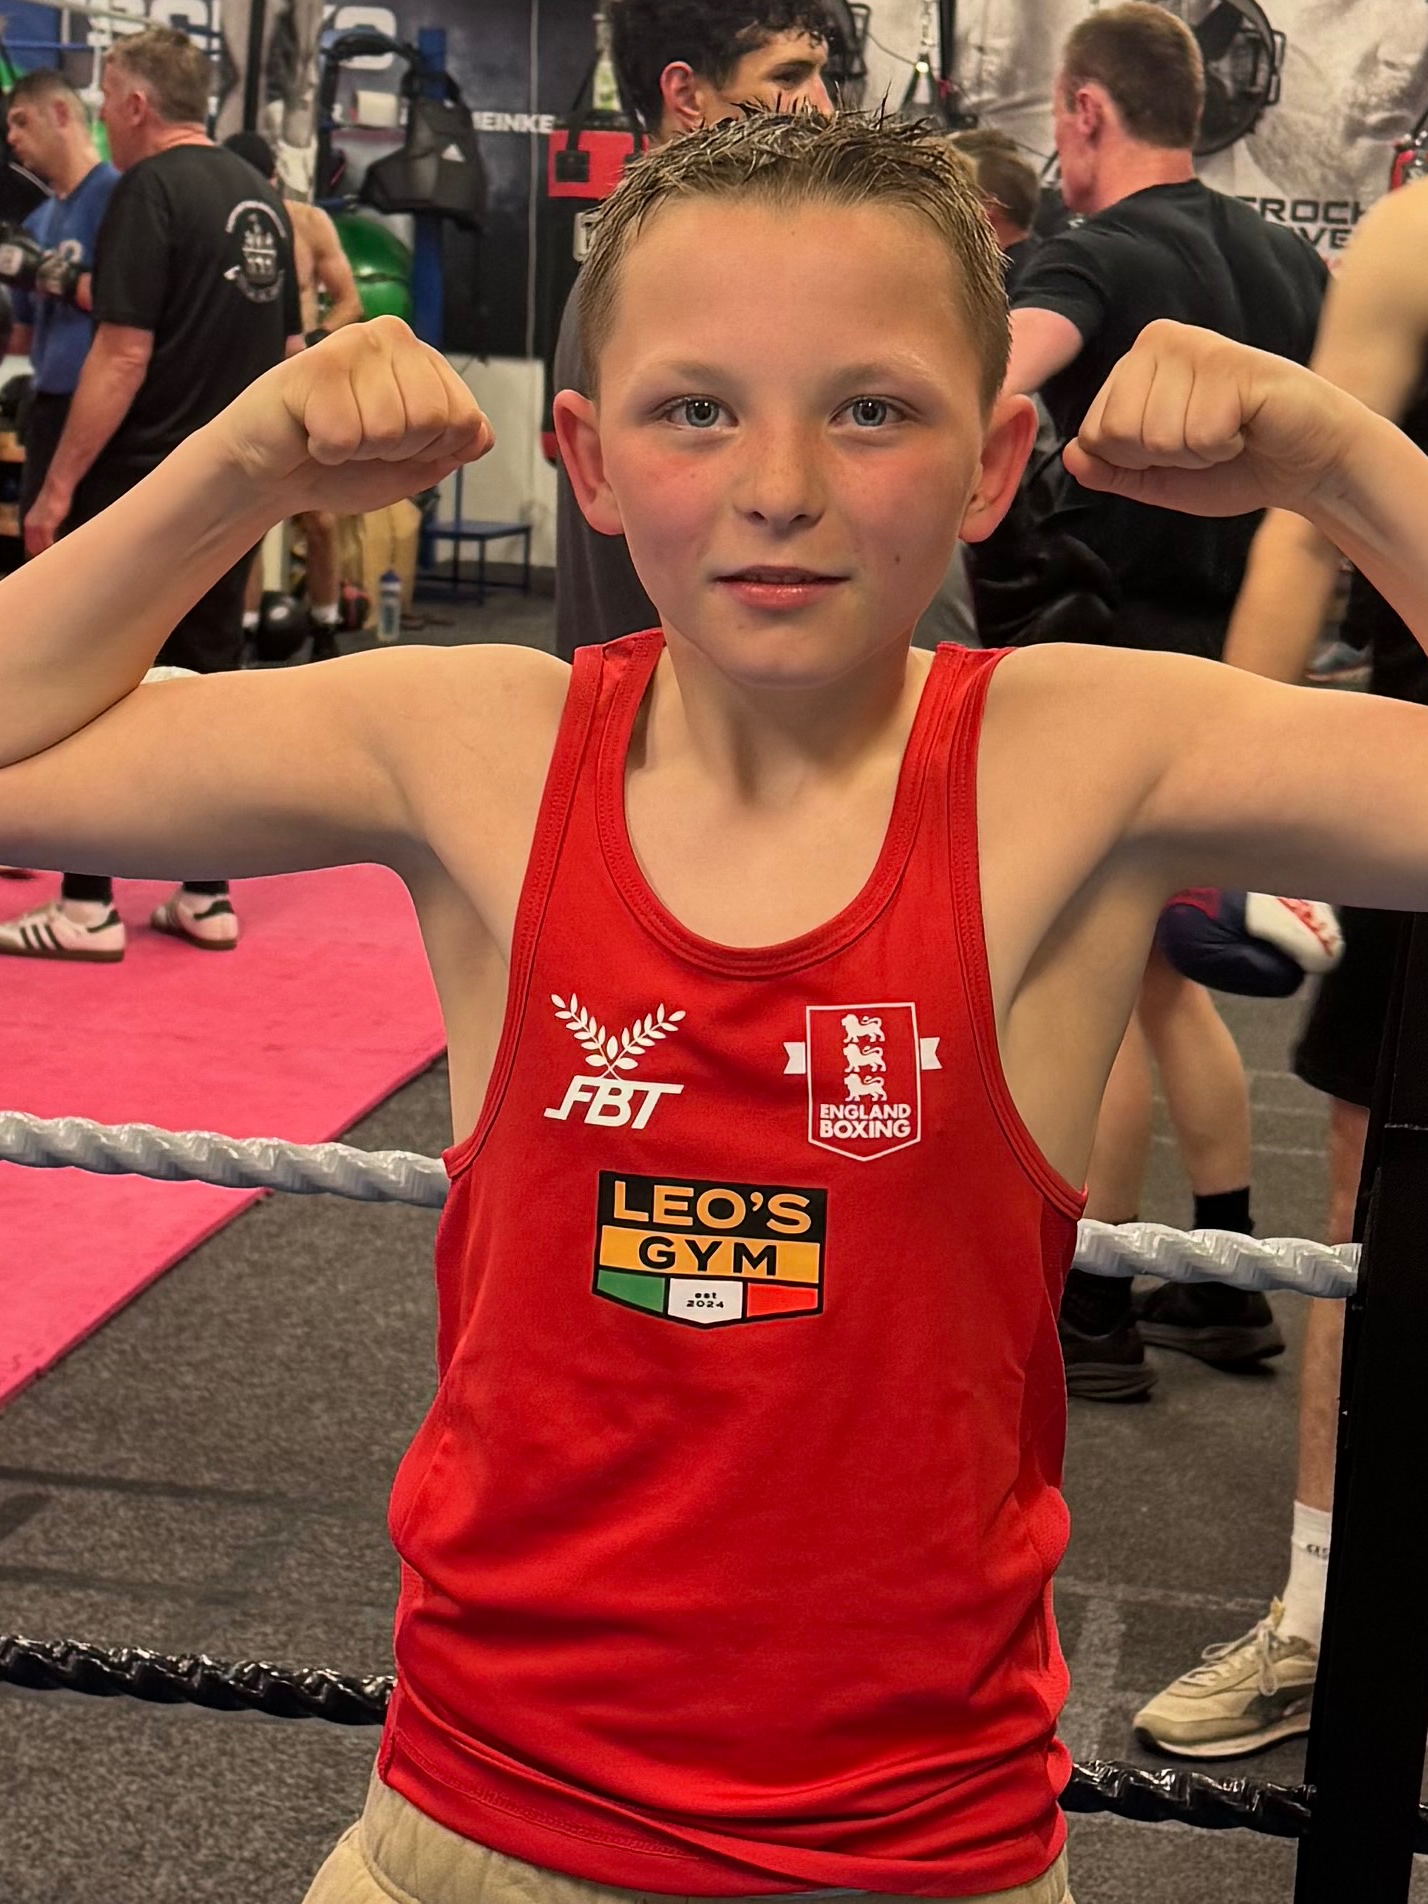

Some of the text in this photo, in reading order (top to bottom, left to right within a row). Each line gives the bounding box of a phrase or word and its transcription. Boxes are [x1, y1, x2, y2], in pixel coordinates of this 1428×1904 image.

[543, 1075, 685, 1130] FBT
[819, 1103, 912, 1122] ENGLAND
[819, 1119, 912, 1140] BOXING
[613, 1179, 812, 1235] LEO'S
[638, 1234, 778, 1277] GYM
[685, 1298, 726, 1309] 2024
[693, 1290, 718, 1301] est
